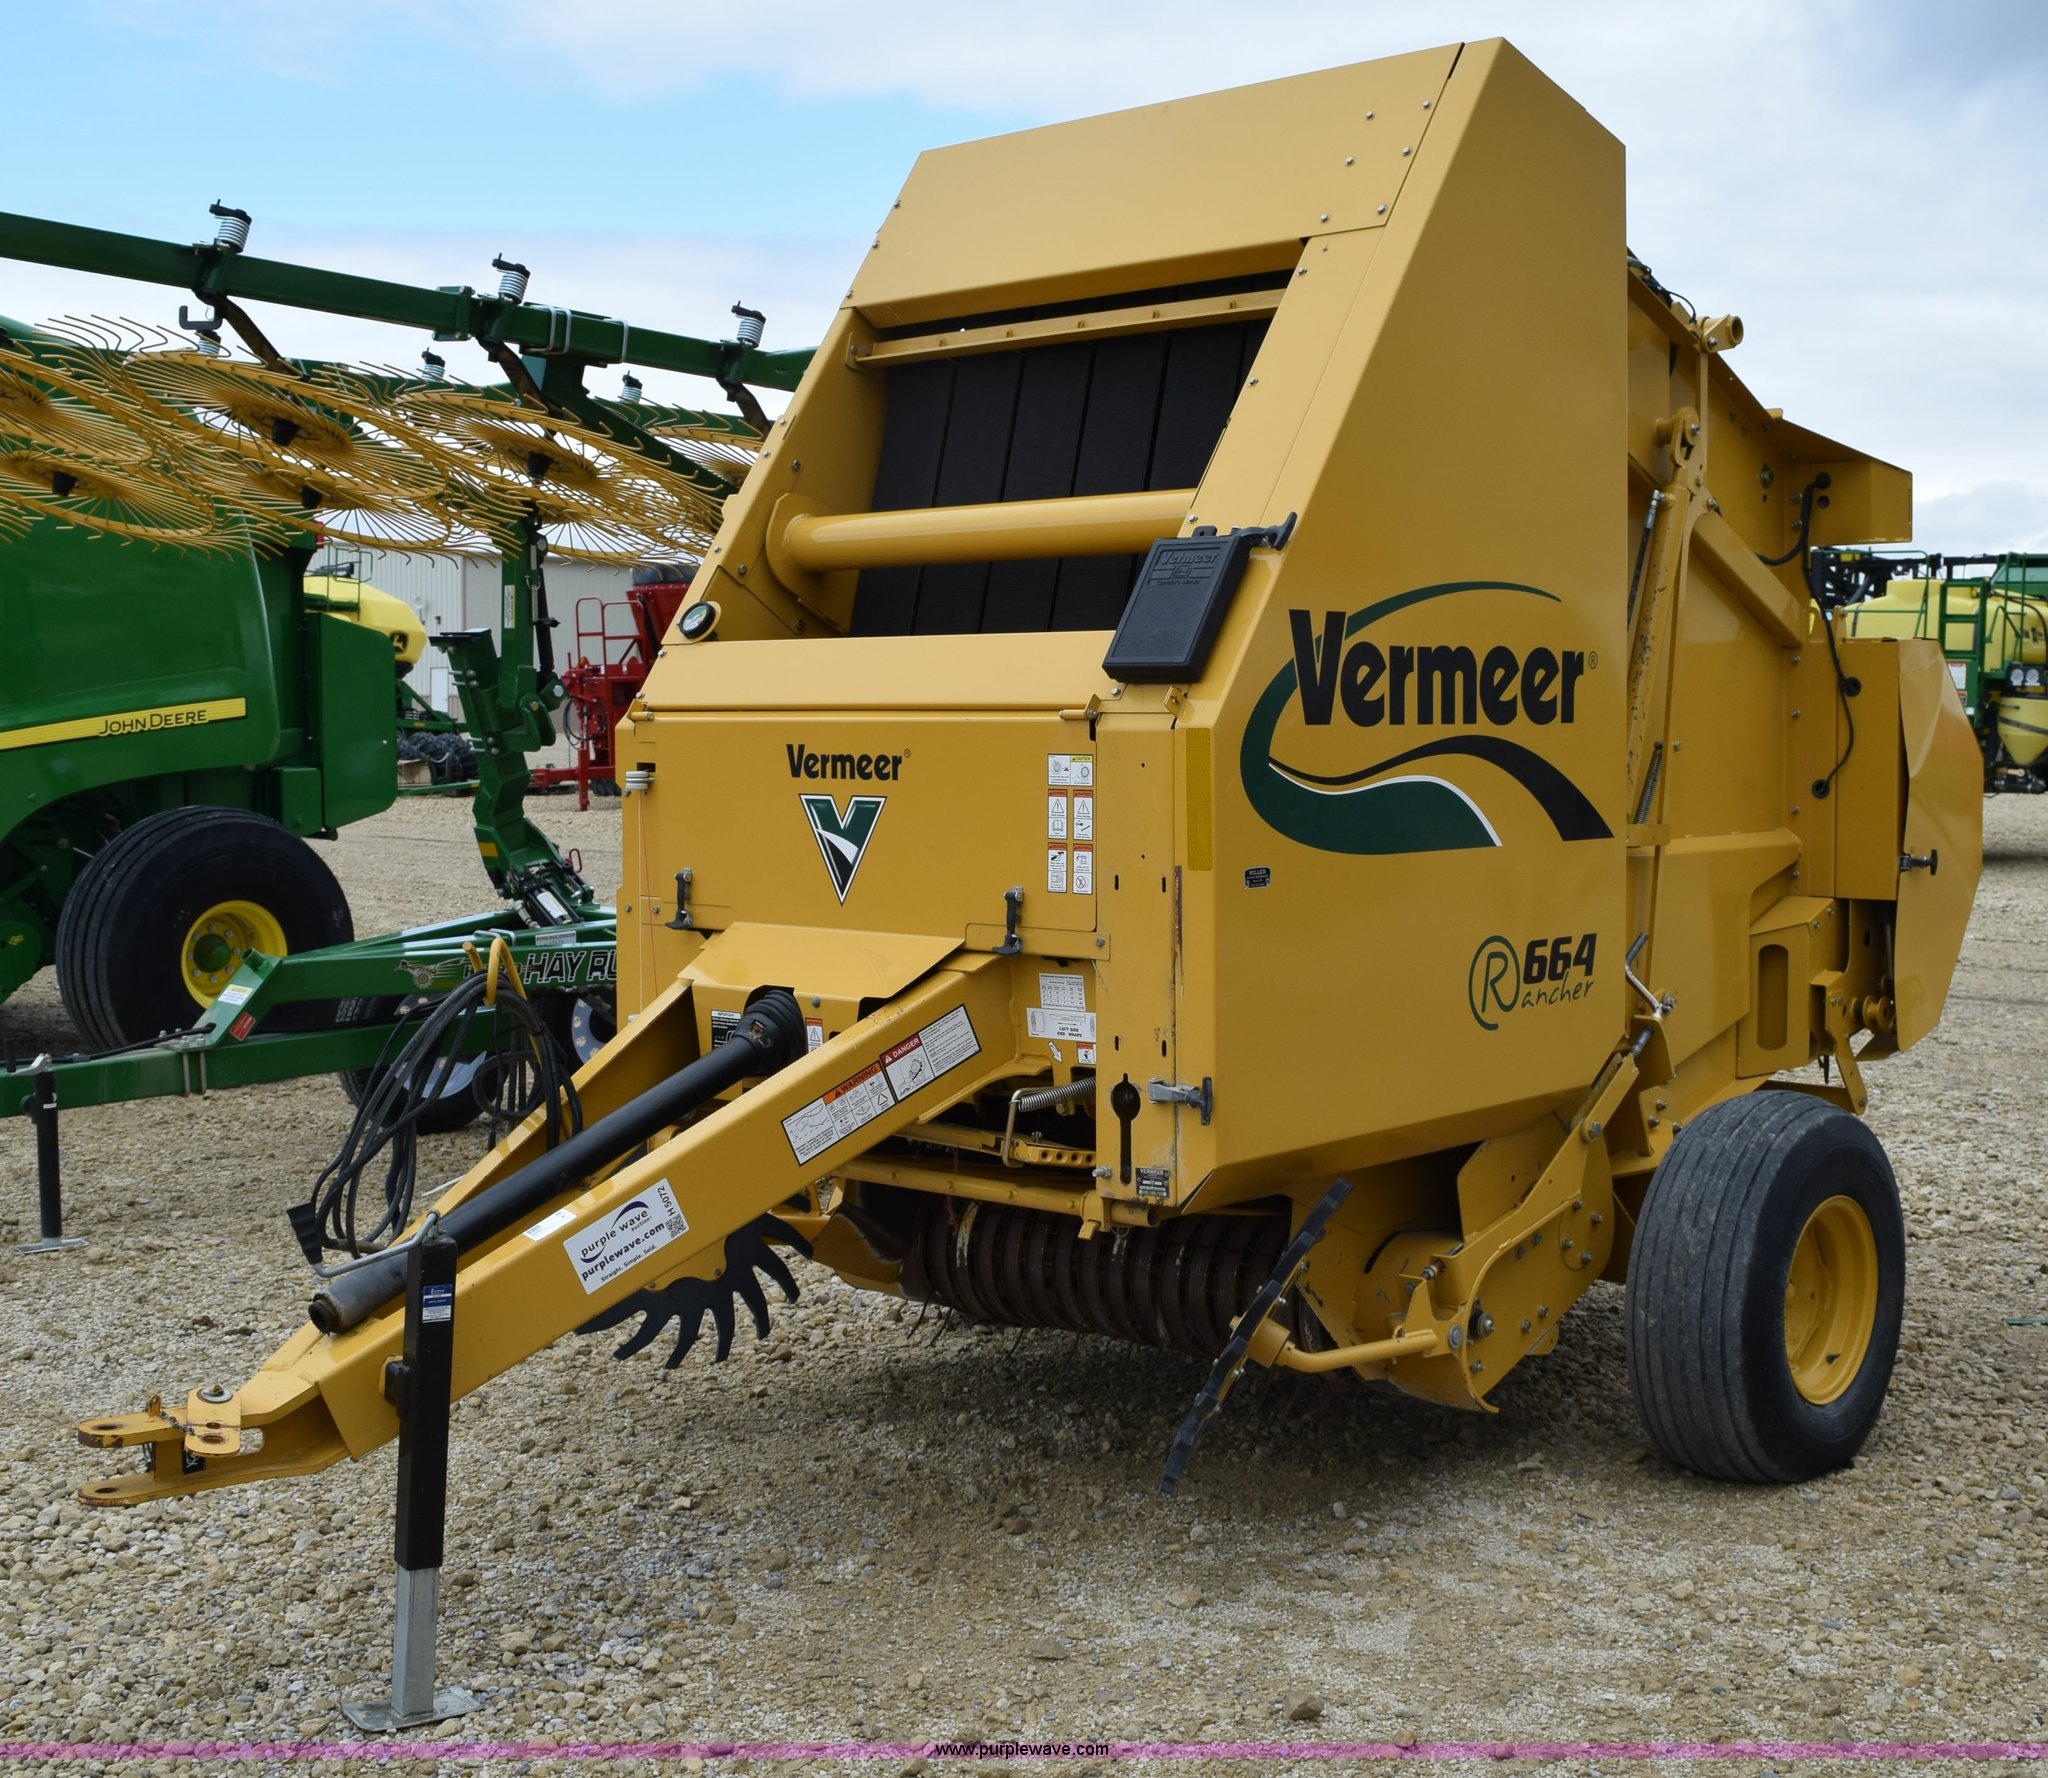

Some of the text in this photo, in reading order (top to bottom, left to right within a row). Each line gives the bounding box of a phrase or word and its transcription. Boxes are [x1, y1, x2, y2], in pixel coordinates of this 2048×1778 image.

[1288, 608, 1584, 728] Vermeer
[99, 709, 207, 735] JOHN DEERE
[786, 743, 903, 781] Vermeer
[523, 950, 587, 984] HAY
[1523, 932, 1597, 985] 664
[892, 1037, 920, 1058] DANGER
[840, 1065, 878, 1093] WARNING
[581, 1209, 648, 1258] purple wave
[581, 1221, 665, 1281] purplewave.com
